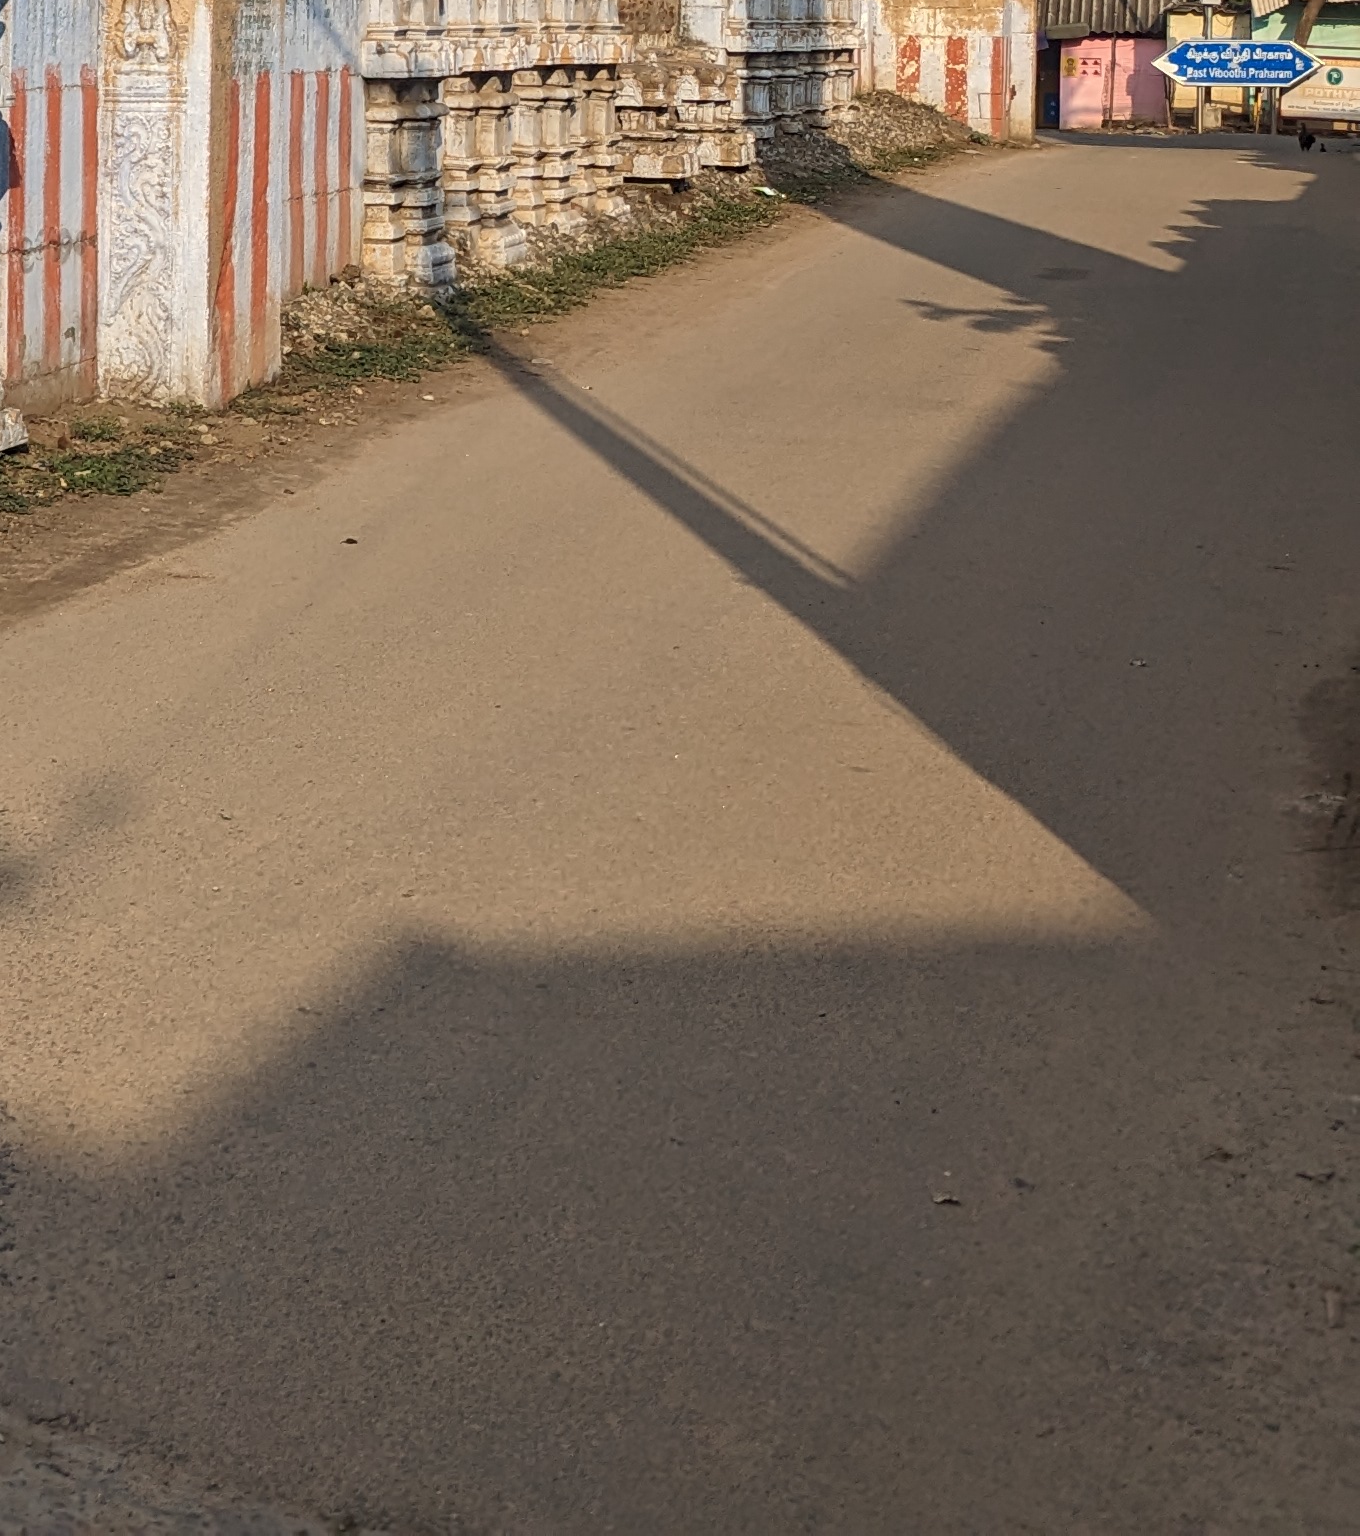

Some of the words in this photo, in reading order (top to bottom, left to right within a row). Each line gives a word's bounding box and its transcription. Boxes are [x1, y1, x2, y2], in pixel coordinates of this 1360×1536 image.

[1186, 48, 1219, 63] கிழக்கு
[1186, 67, 1207, 79] East
[1209, 66, 1247, 78] Viboothi
[1249, 67, 1293, 79] Praharam
